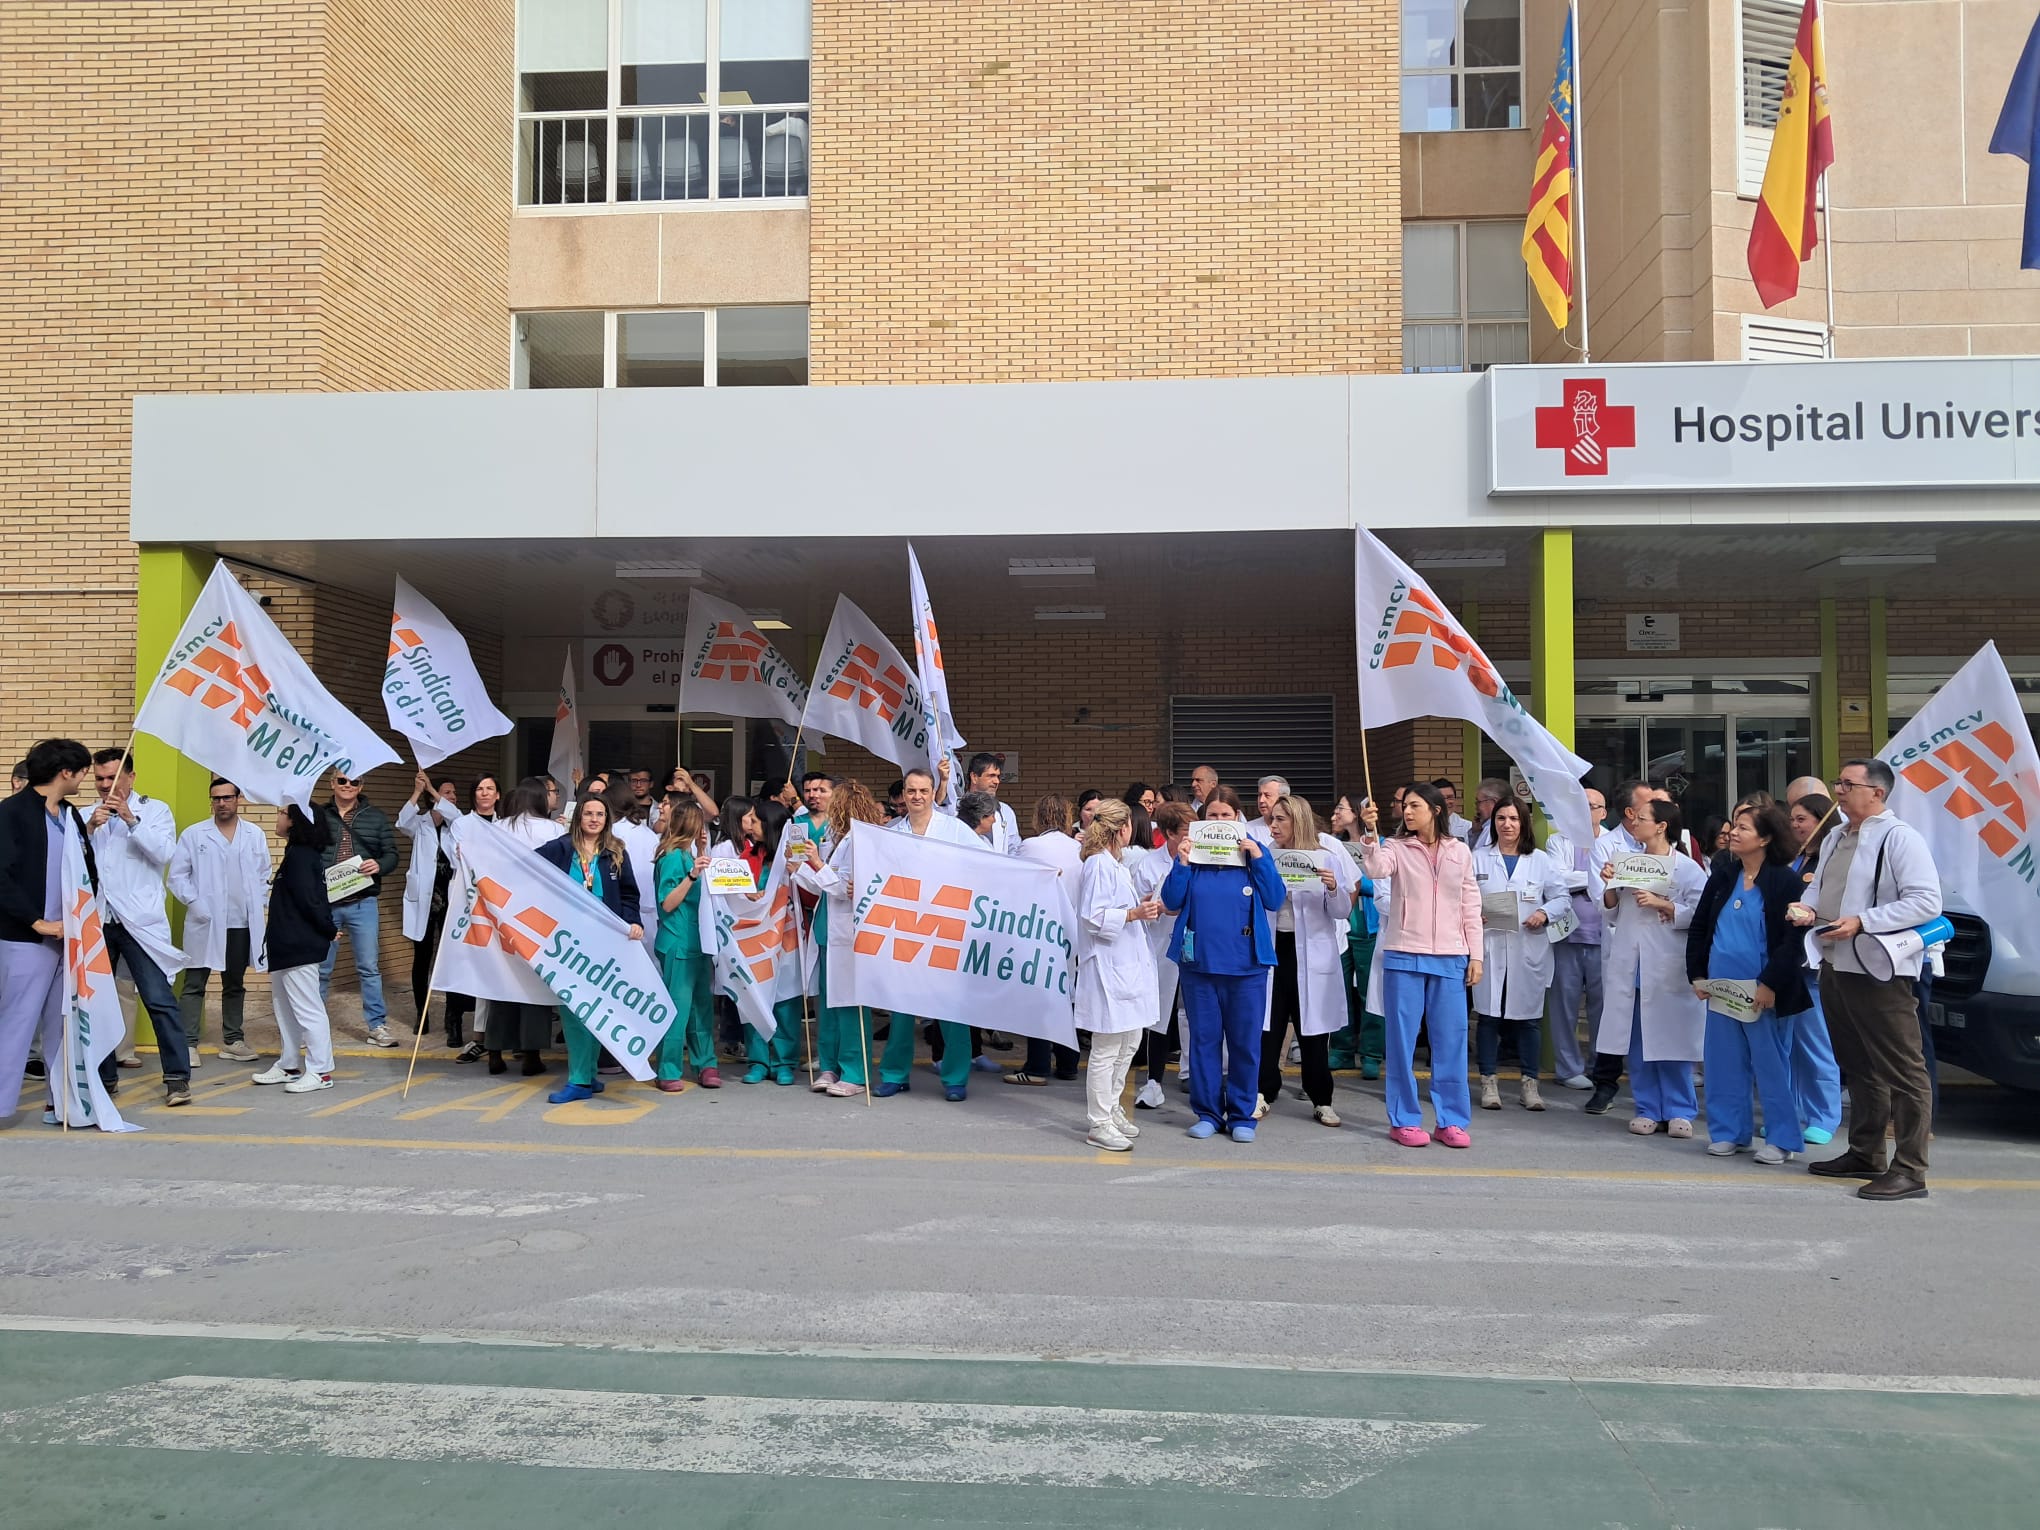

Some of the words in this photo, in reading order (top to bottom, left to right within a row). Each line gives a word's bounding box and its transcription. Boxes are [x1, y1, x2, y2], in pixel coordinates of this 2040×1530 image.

[1674, 401, 1863, 451] Hospital
[159, 616, 224, 678] esmcv
[690, 622, 717, 677] cesmcv
[1369, 579, 1407, 669] cesmcv
[642, 649, 684, 663] Prohi
[652, 671, 665, 683] el
[820, 638, 854, 692] cesmcv
[384, 661, 431, 739] Médi
[402, 646, 466, 732] Sindicato
[1889, 709, 1984, 768] cesmcv
[1203, 833, 1237, 841] HUELGA
[1281, 861, 1312, 869] HUELGA
[1626, 865, 1661, 874] HUELGA
[853, 873, 883, 927] smcv
[543, 929, 668, 1025] Sindicato
[962, 939, 1067, 994] Médic
[534, 963, 646, 1056] Médico
